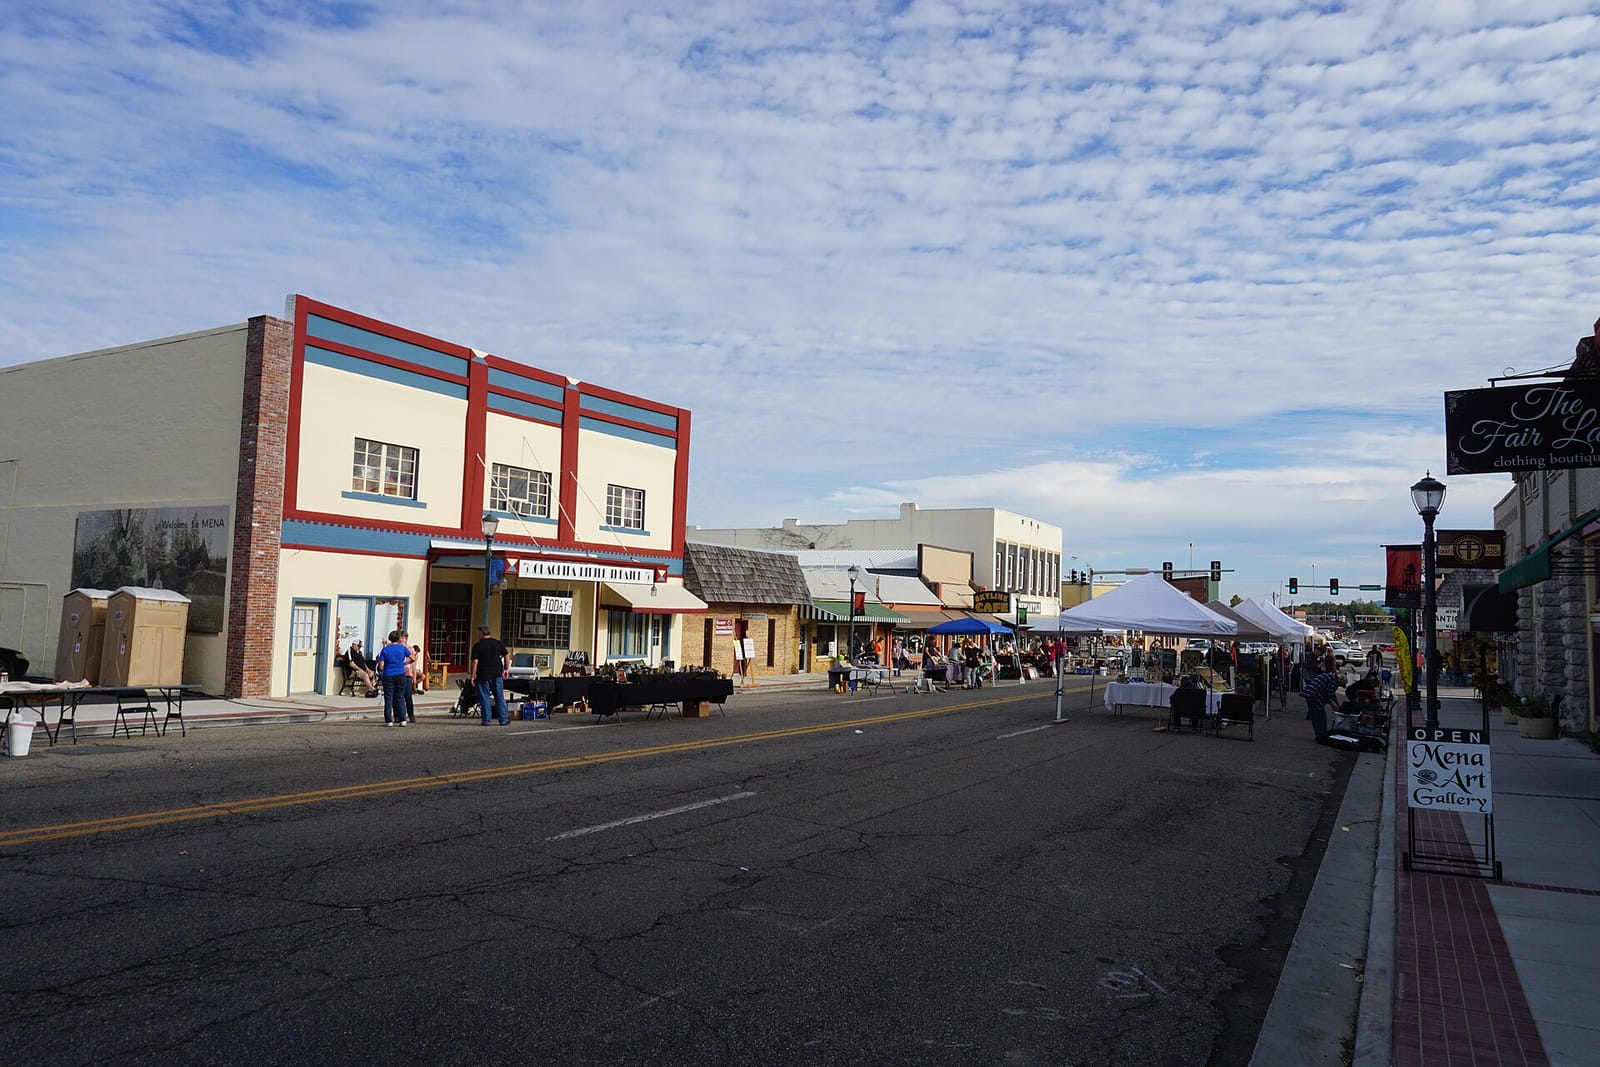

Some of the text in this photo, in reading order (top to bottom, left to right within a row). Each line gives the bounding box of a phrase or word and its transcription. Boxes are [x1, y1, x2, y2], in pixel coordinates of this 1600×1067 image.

[1511, 387, 1583, 421] The
[1458, 408, 1600, 455] Fair La
[1494, 452, 1600, 469] clothing boutiqu
[161, 519, 188, 529] Welcome
[201, 518, 225, 529] MENA
[545, 598, 569, 613] TODAY
[975, 602, 1009, 613] CAFE
[1414, 729, 1481, 743] OPEN
[1412, 743, 1485, 771] Mena
[1441, 768, 1487, 795] Art
[1413, 787, 1488, 813] Gallery
